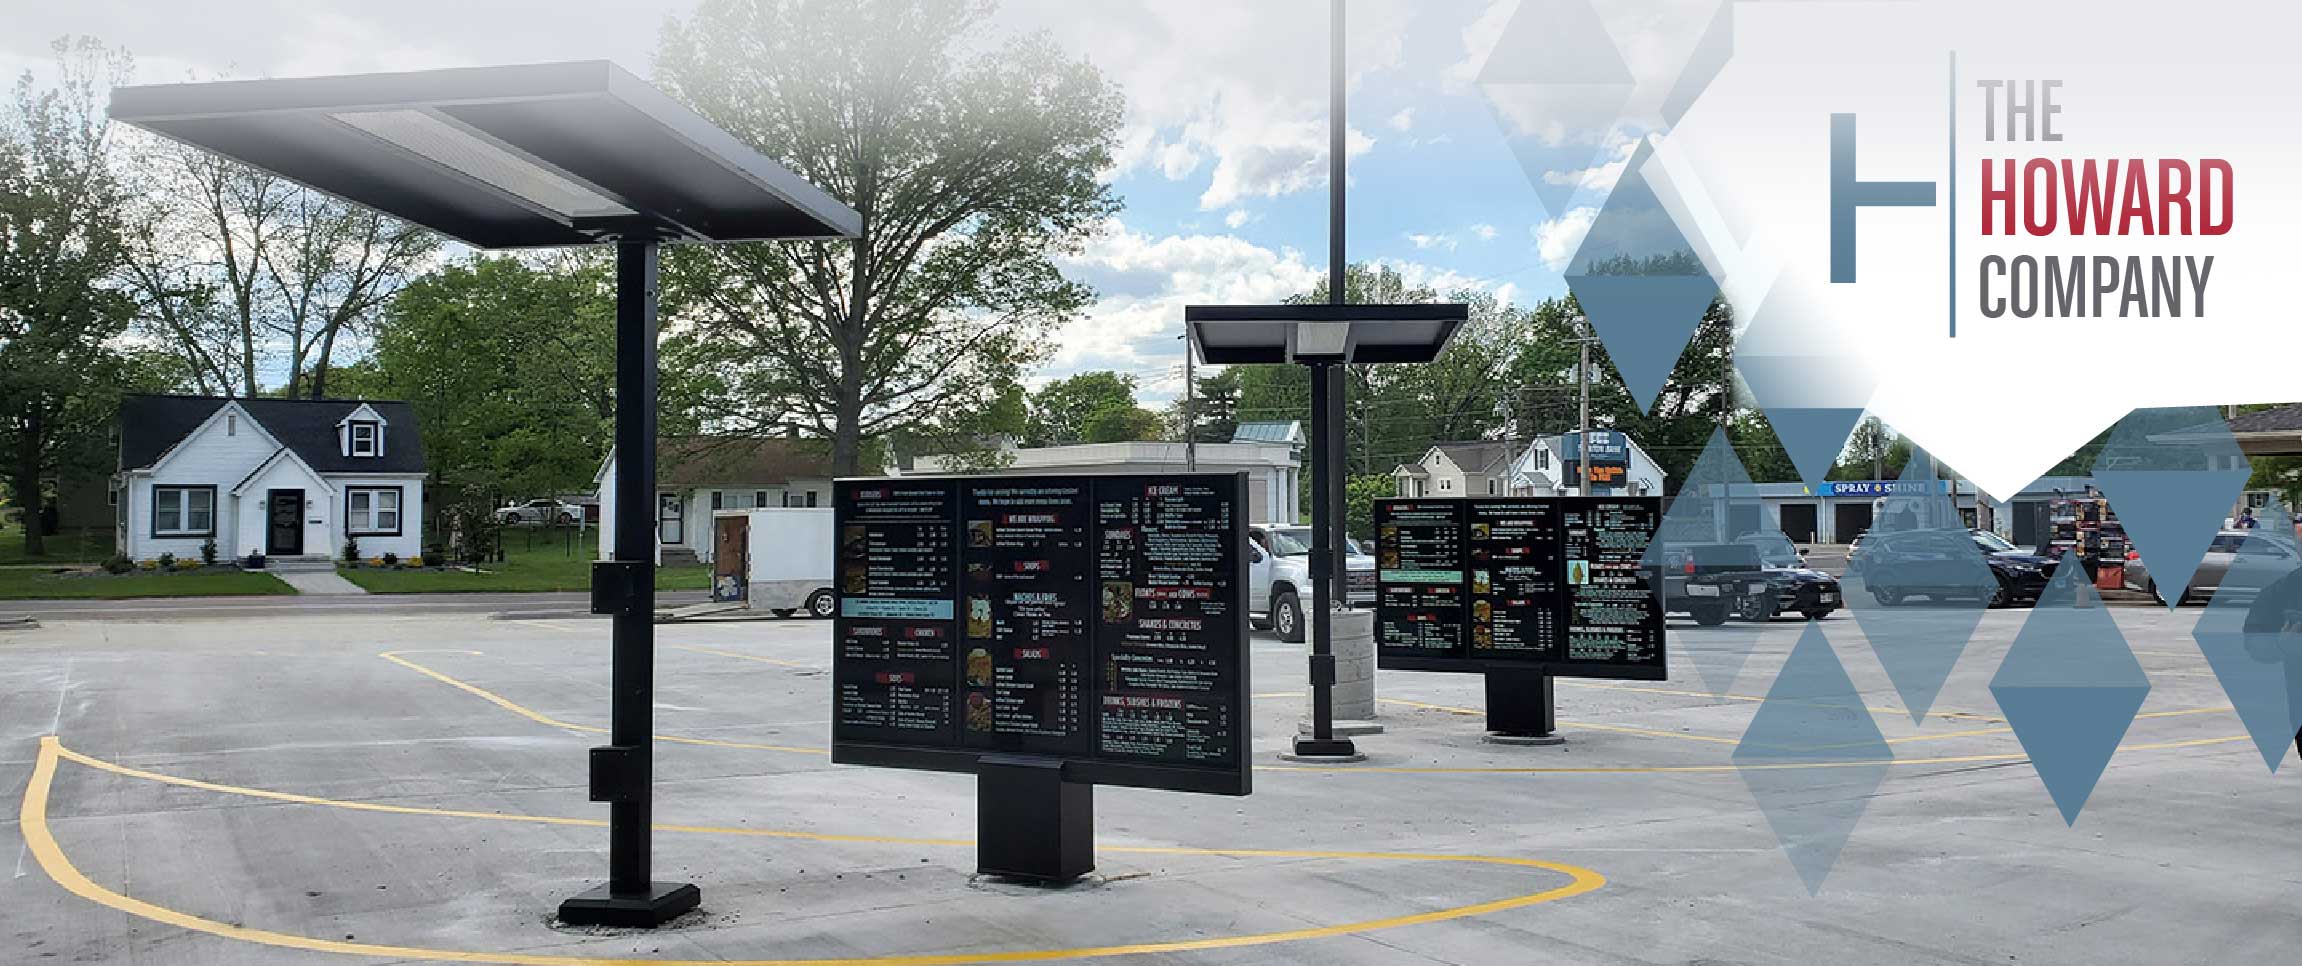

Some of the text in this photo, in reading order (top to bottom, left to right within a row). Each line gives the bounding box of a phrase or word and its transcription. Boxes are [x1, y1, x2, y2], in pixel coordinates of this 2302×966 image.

[1148, 486, 1157, 496] ICE
[1158, 486, 1179, 496] CREAM
[1834, 483, 1926, 493] SPRAY SHINE
[1139, 618, 1162, 629] SHAKES
[1168, 619, 1201, 630] CONCRETES
